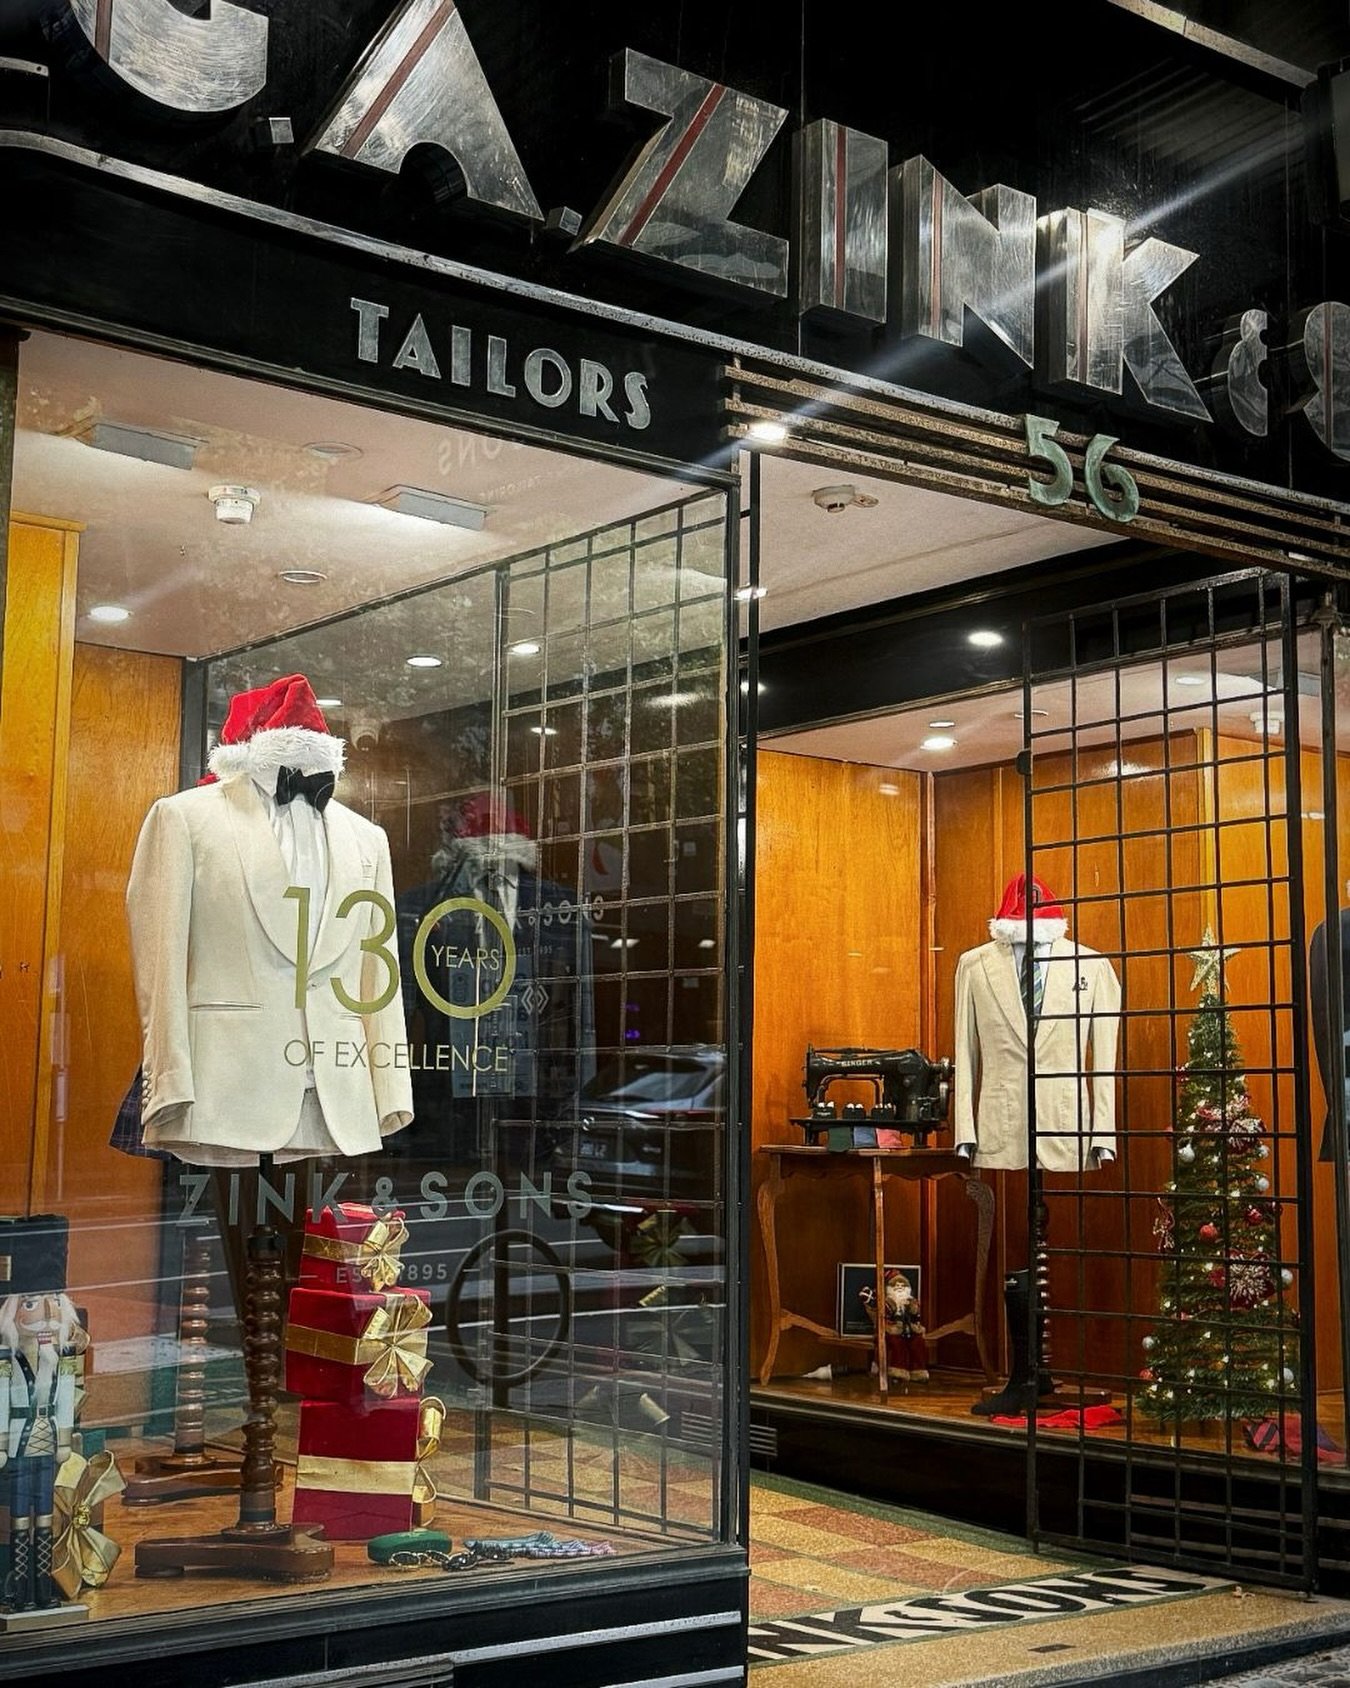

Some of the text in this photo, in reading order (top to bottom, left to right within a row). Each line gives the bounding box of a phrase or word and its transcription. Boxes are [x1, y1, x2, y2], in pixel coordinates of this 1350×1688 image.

[351, 297, 651, 430] TAILORS
[1024, 413, 1140, 522] 56
[282, 886, 517, 1020] 130
[431, 944, 501, 971] YEARS
[283, 1039, 509, 1073] OF EXCELLENCE
[176, 1170, 593, 1228] ZINK & SONS
[398, 1263, 448, 1281] 895
